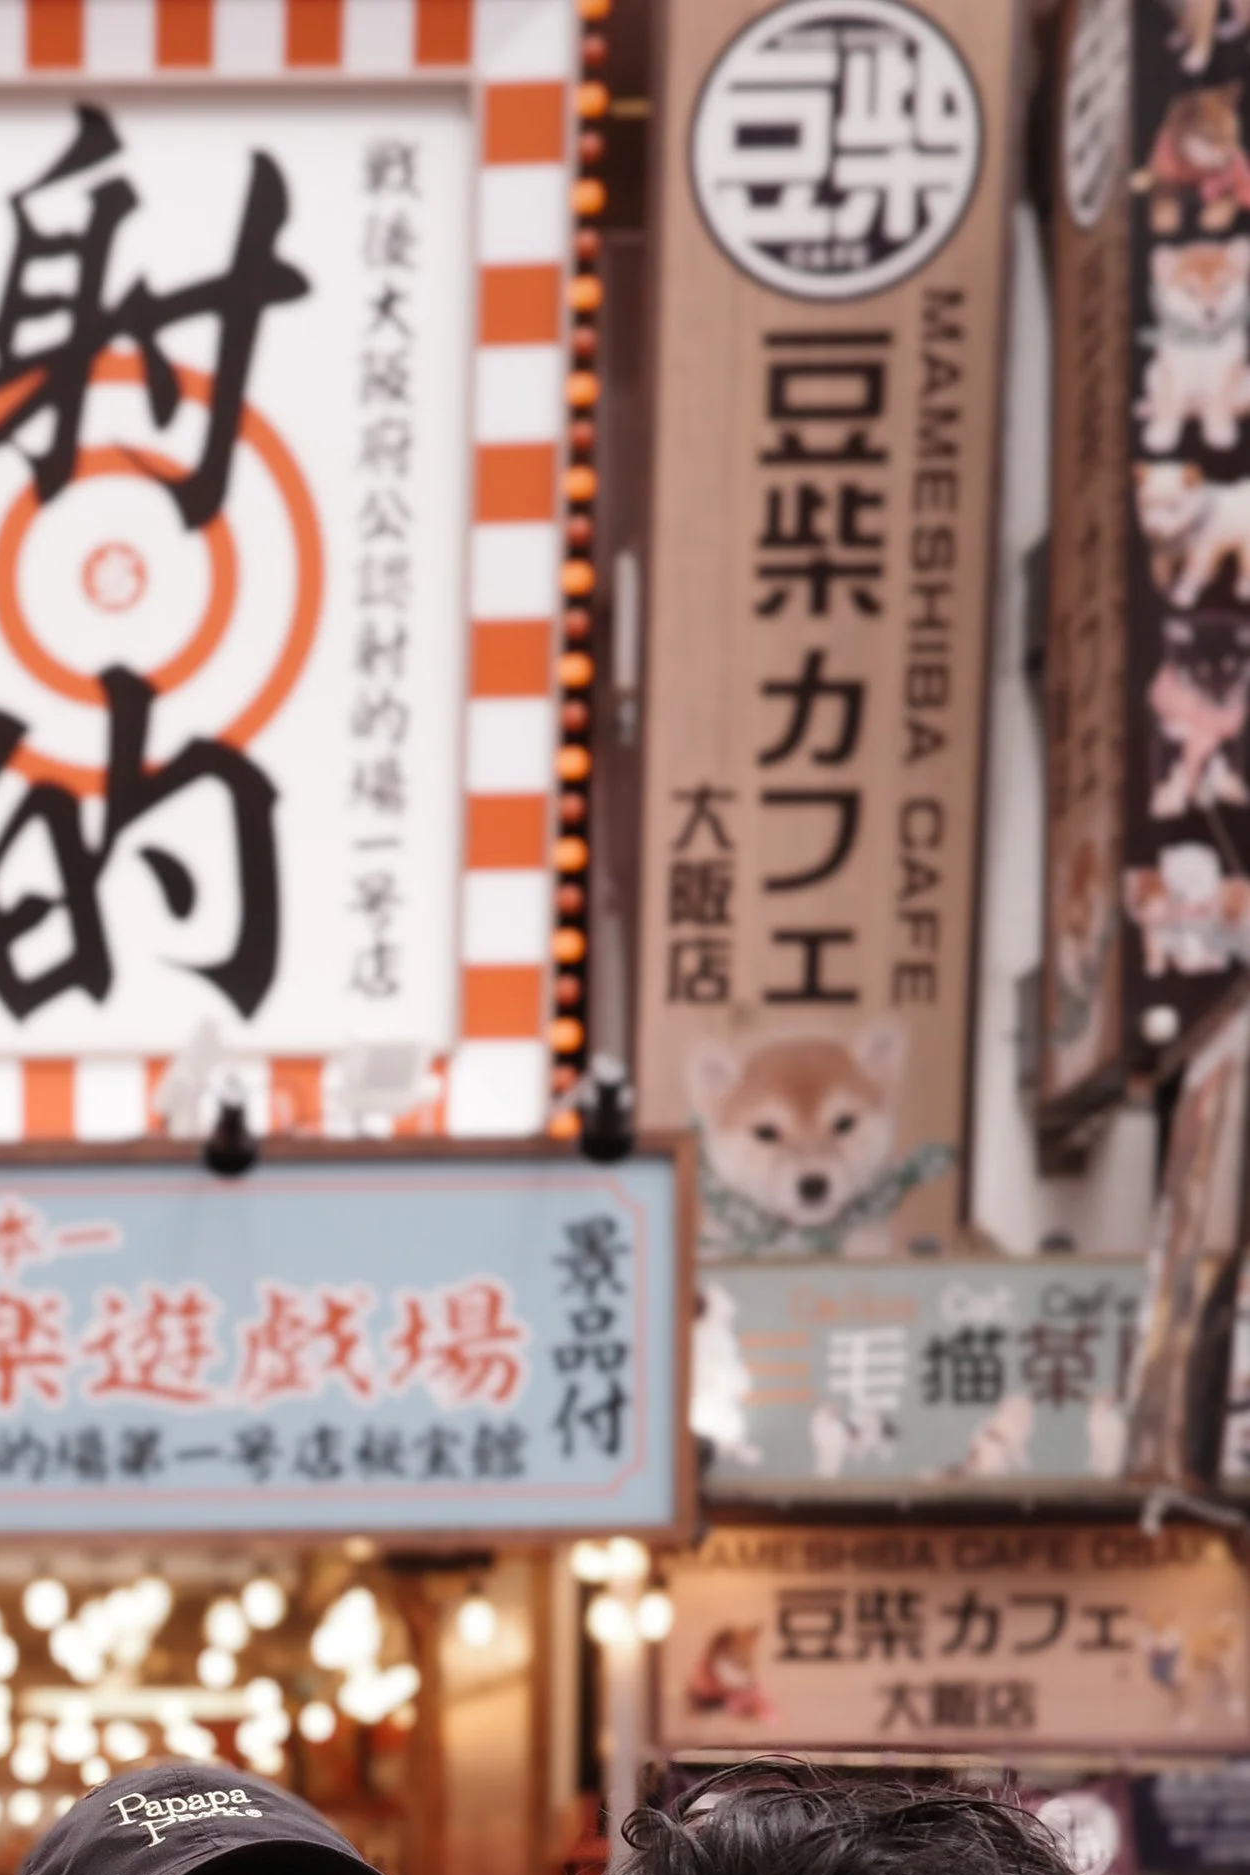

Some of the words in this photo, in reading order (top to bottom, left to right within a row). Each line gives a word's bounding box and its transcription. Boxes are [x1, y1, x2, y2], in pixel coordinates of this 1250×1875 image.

[901, 288, 968, 766] MAMESHIBA
[890, 796, 946, 1006] CAFE
[550, 1212, 634, 1462] 景品付
[738, 1322, 1146, 1412] 三毛猫茶
[109, 1788, 253, 1827] Papapa
